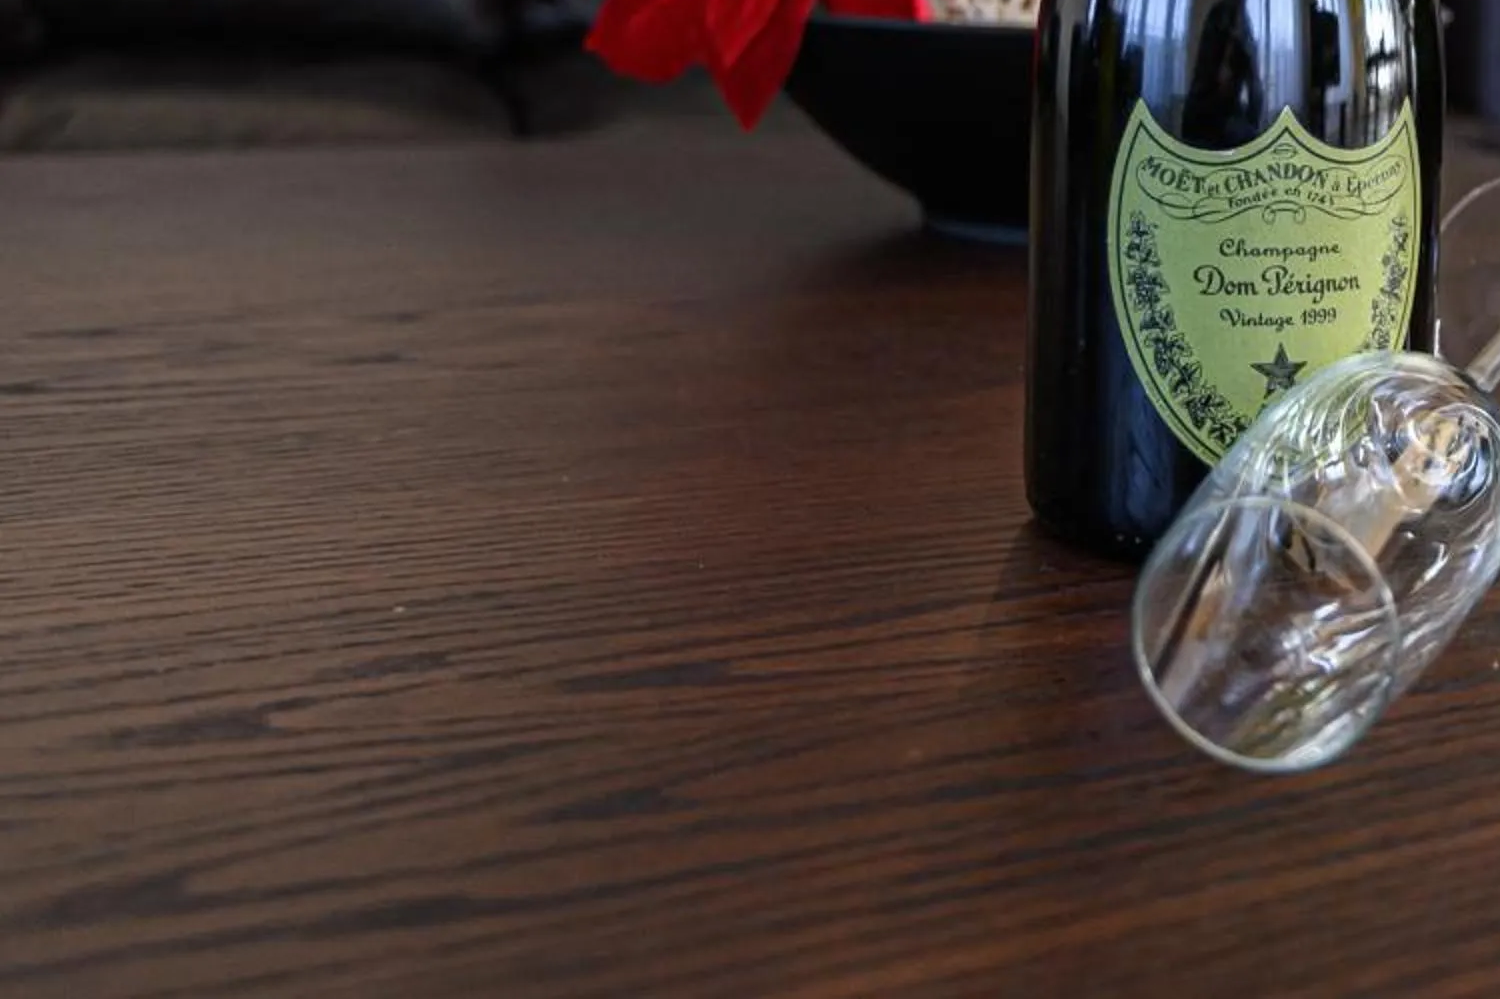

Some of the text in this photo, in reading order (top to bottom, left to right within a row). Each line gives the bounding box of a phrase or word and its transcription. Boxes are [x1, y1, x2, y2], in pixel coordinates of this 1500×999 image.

[1141, 155, 1205, 194] MOËT
[1224, 162, 1328, 193] CHANDON
[1219, 238, 1341, 263] Champagne
[1193, 264, 1361, 304] Dom Pérignon
[1219, 306, 1337, 333] Vintage 1999
